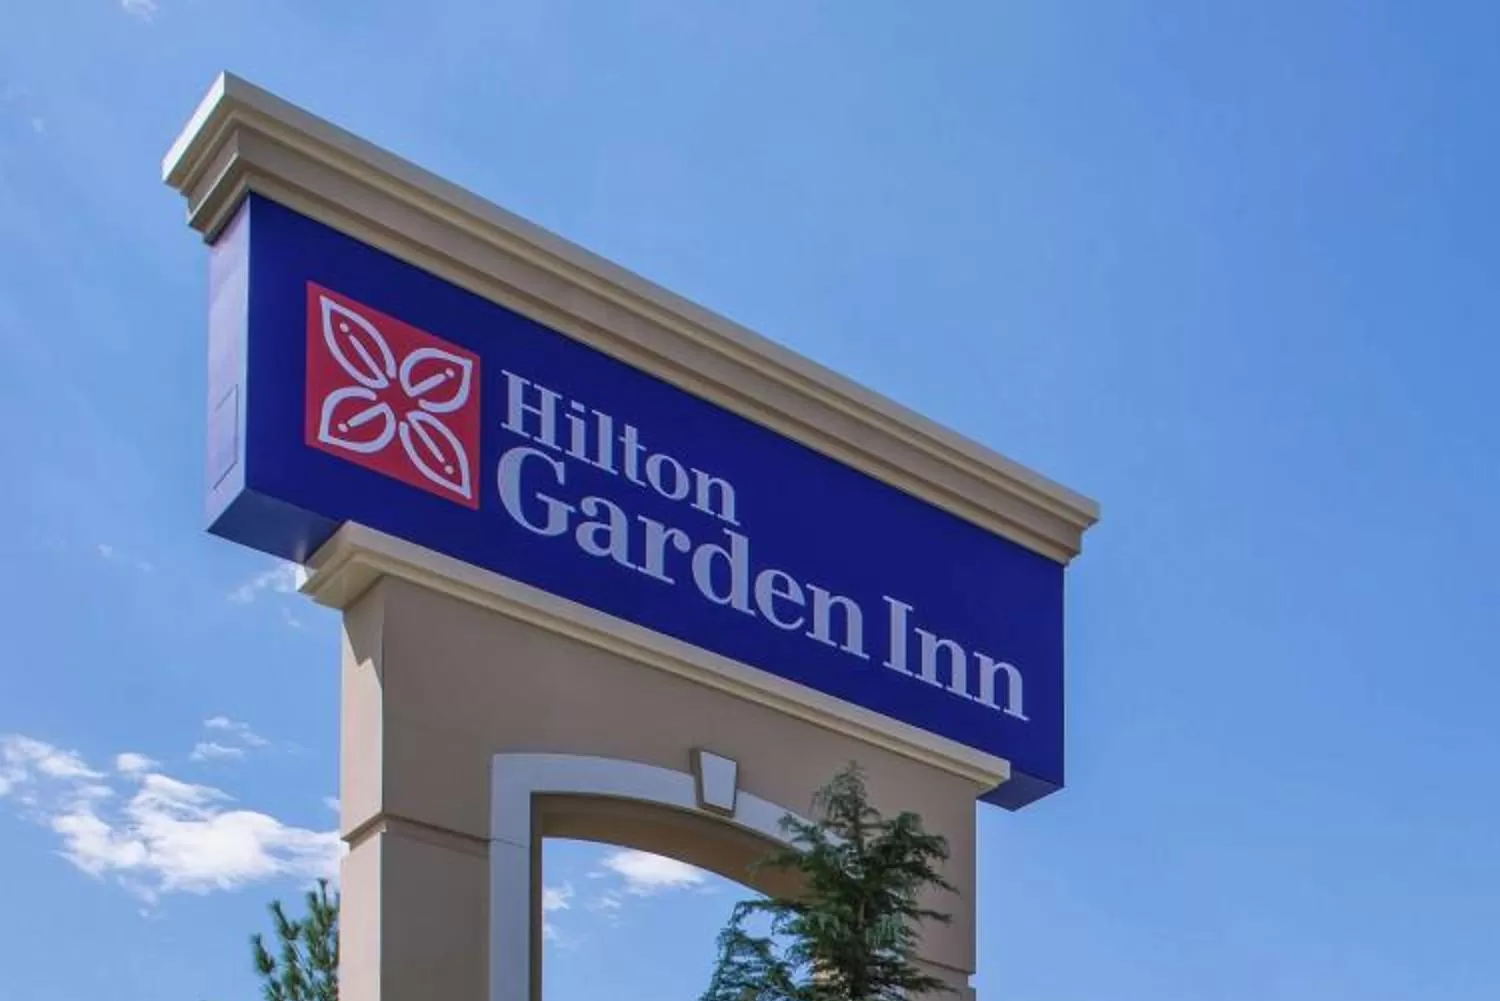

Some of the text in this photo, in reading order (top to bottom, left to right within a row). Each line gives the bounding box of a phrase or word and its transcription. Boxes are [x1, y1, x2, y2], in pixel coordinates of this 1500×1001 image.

[501, 369, 741, 526] Hilton
[498, 446, 1030, 721] Garden Inn
